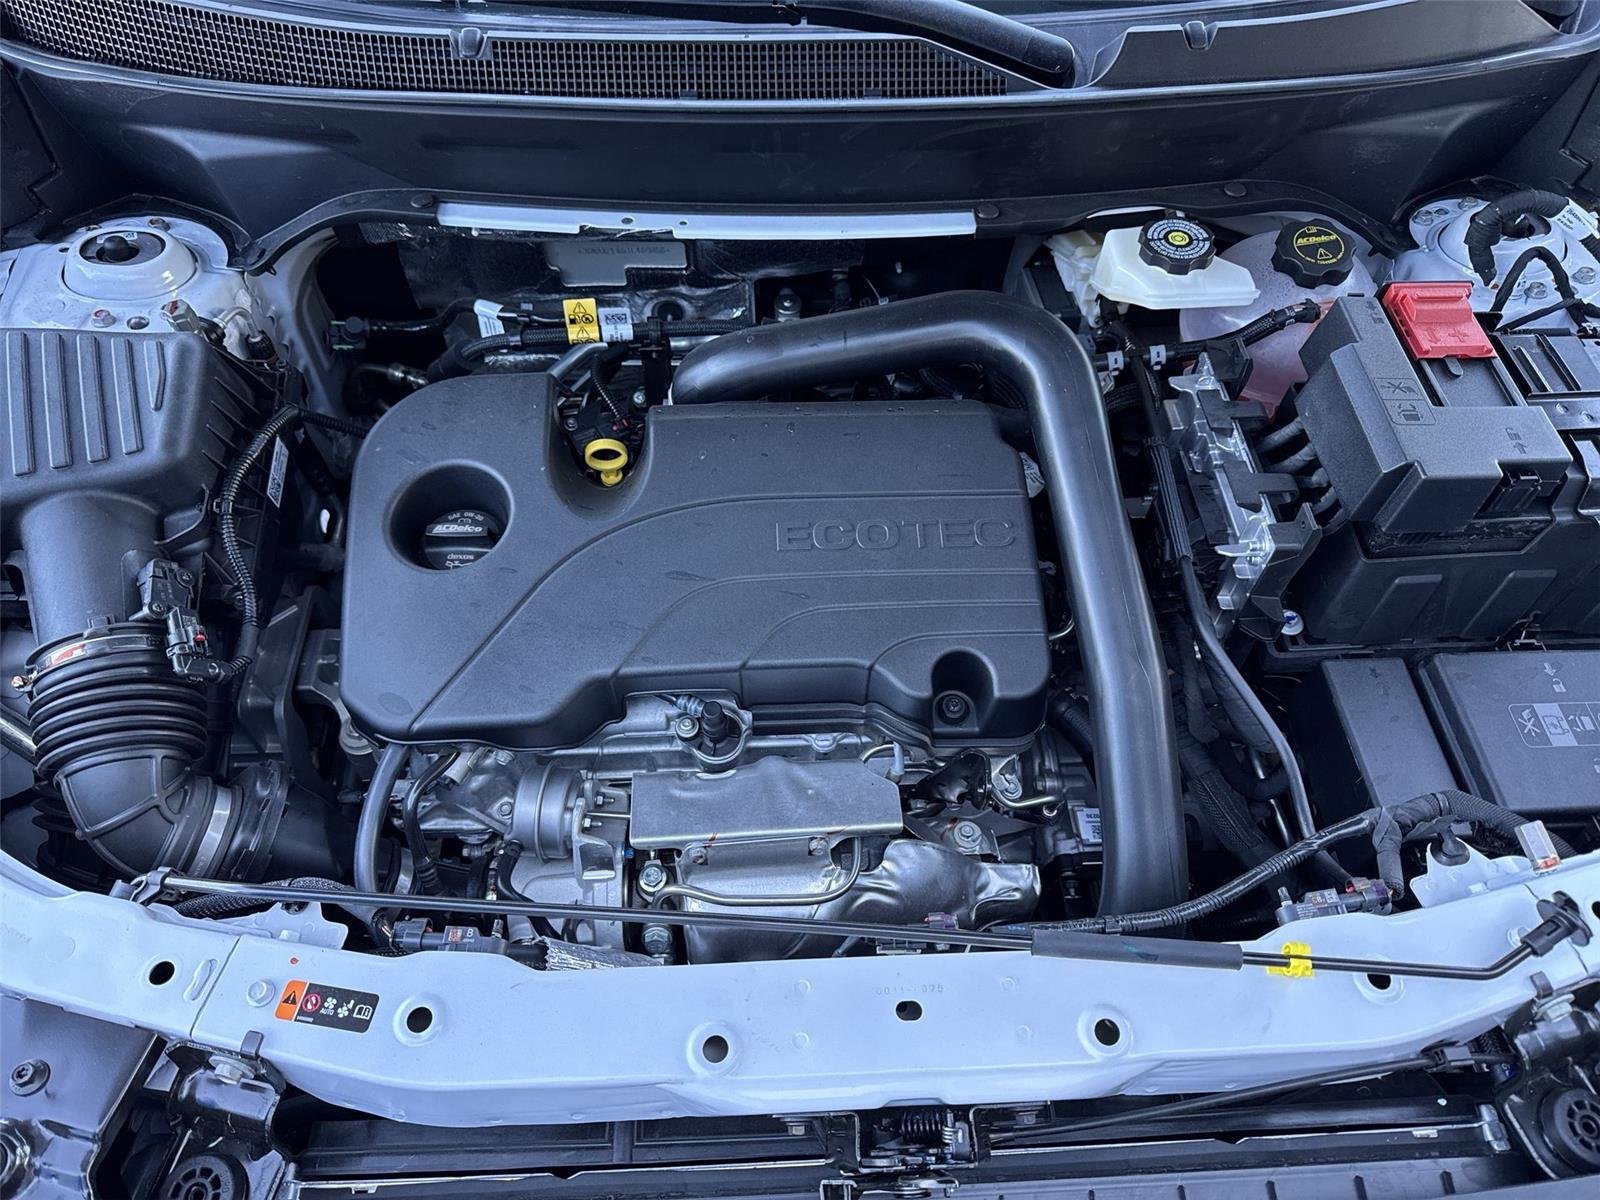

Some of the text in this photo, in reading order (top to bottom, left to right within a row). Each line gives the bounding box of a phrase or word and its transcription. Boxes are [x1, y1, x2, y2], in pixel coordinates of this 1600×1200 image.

[1296, 235, 1337, 246] ACDelco
[448, 512, 461, 520] SAE
[432, 524, 483, 533] ACDelco
[775, 518, 1017, 552] ECOTEC
[319, 1008, 335, 1016] AUTO
